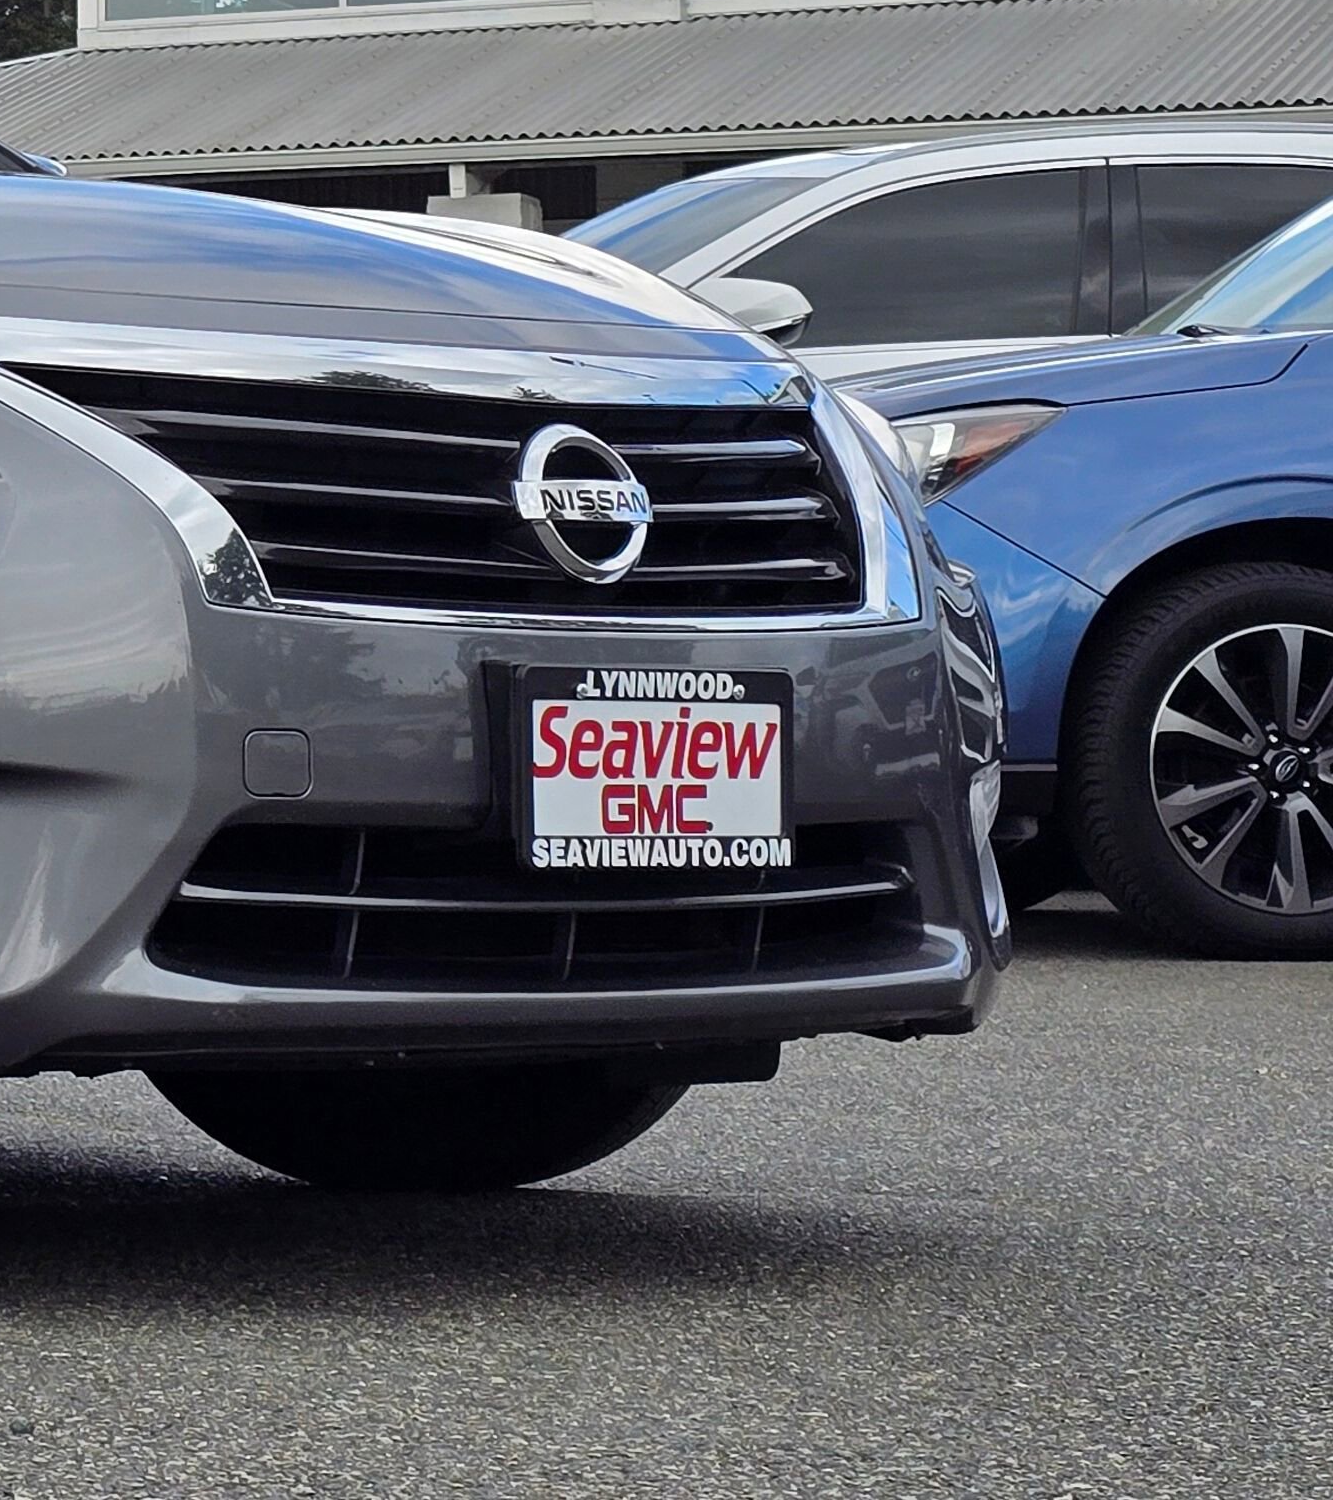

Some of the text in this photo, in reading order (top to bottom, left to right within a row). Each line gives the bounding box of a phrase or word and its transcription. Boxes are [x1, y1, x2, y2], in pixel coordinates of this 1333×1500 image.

[540, 488, 648, 514] NISSAN
[585, 669, 734, 700] LYNNWOOD
[532, 705, 778, 780] Seaview
[601, 783, 712, 835] GMC
[531, 837, 792, 868] SEAVIEWAUTO.COM
